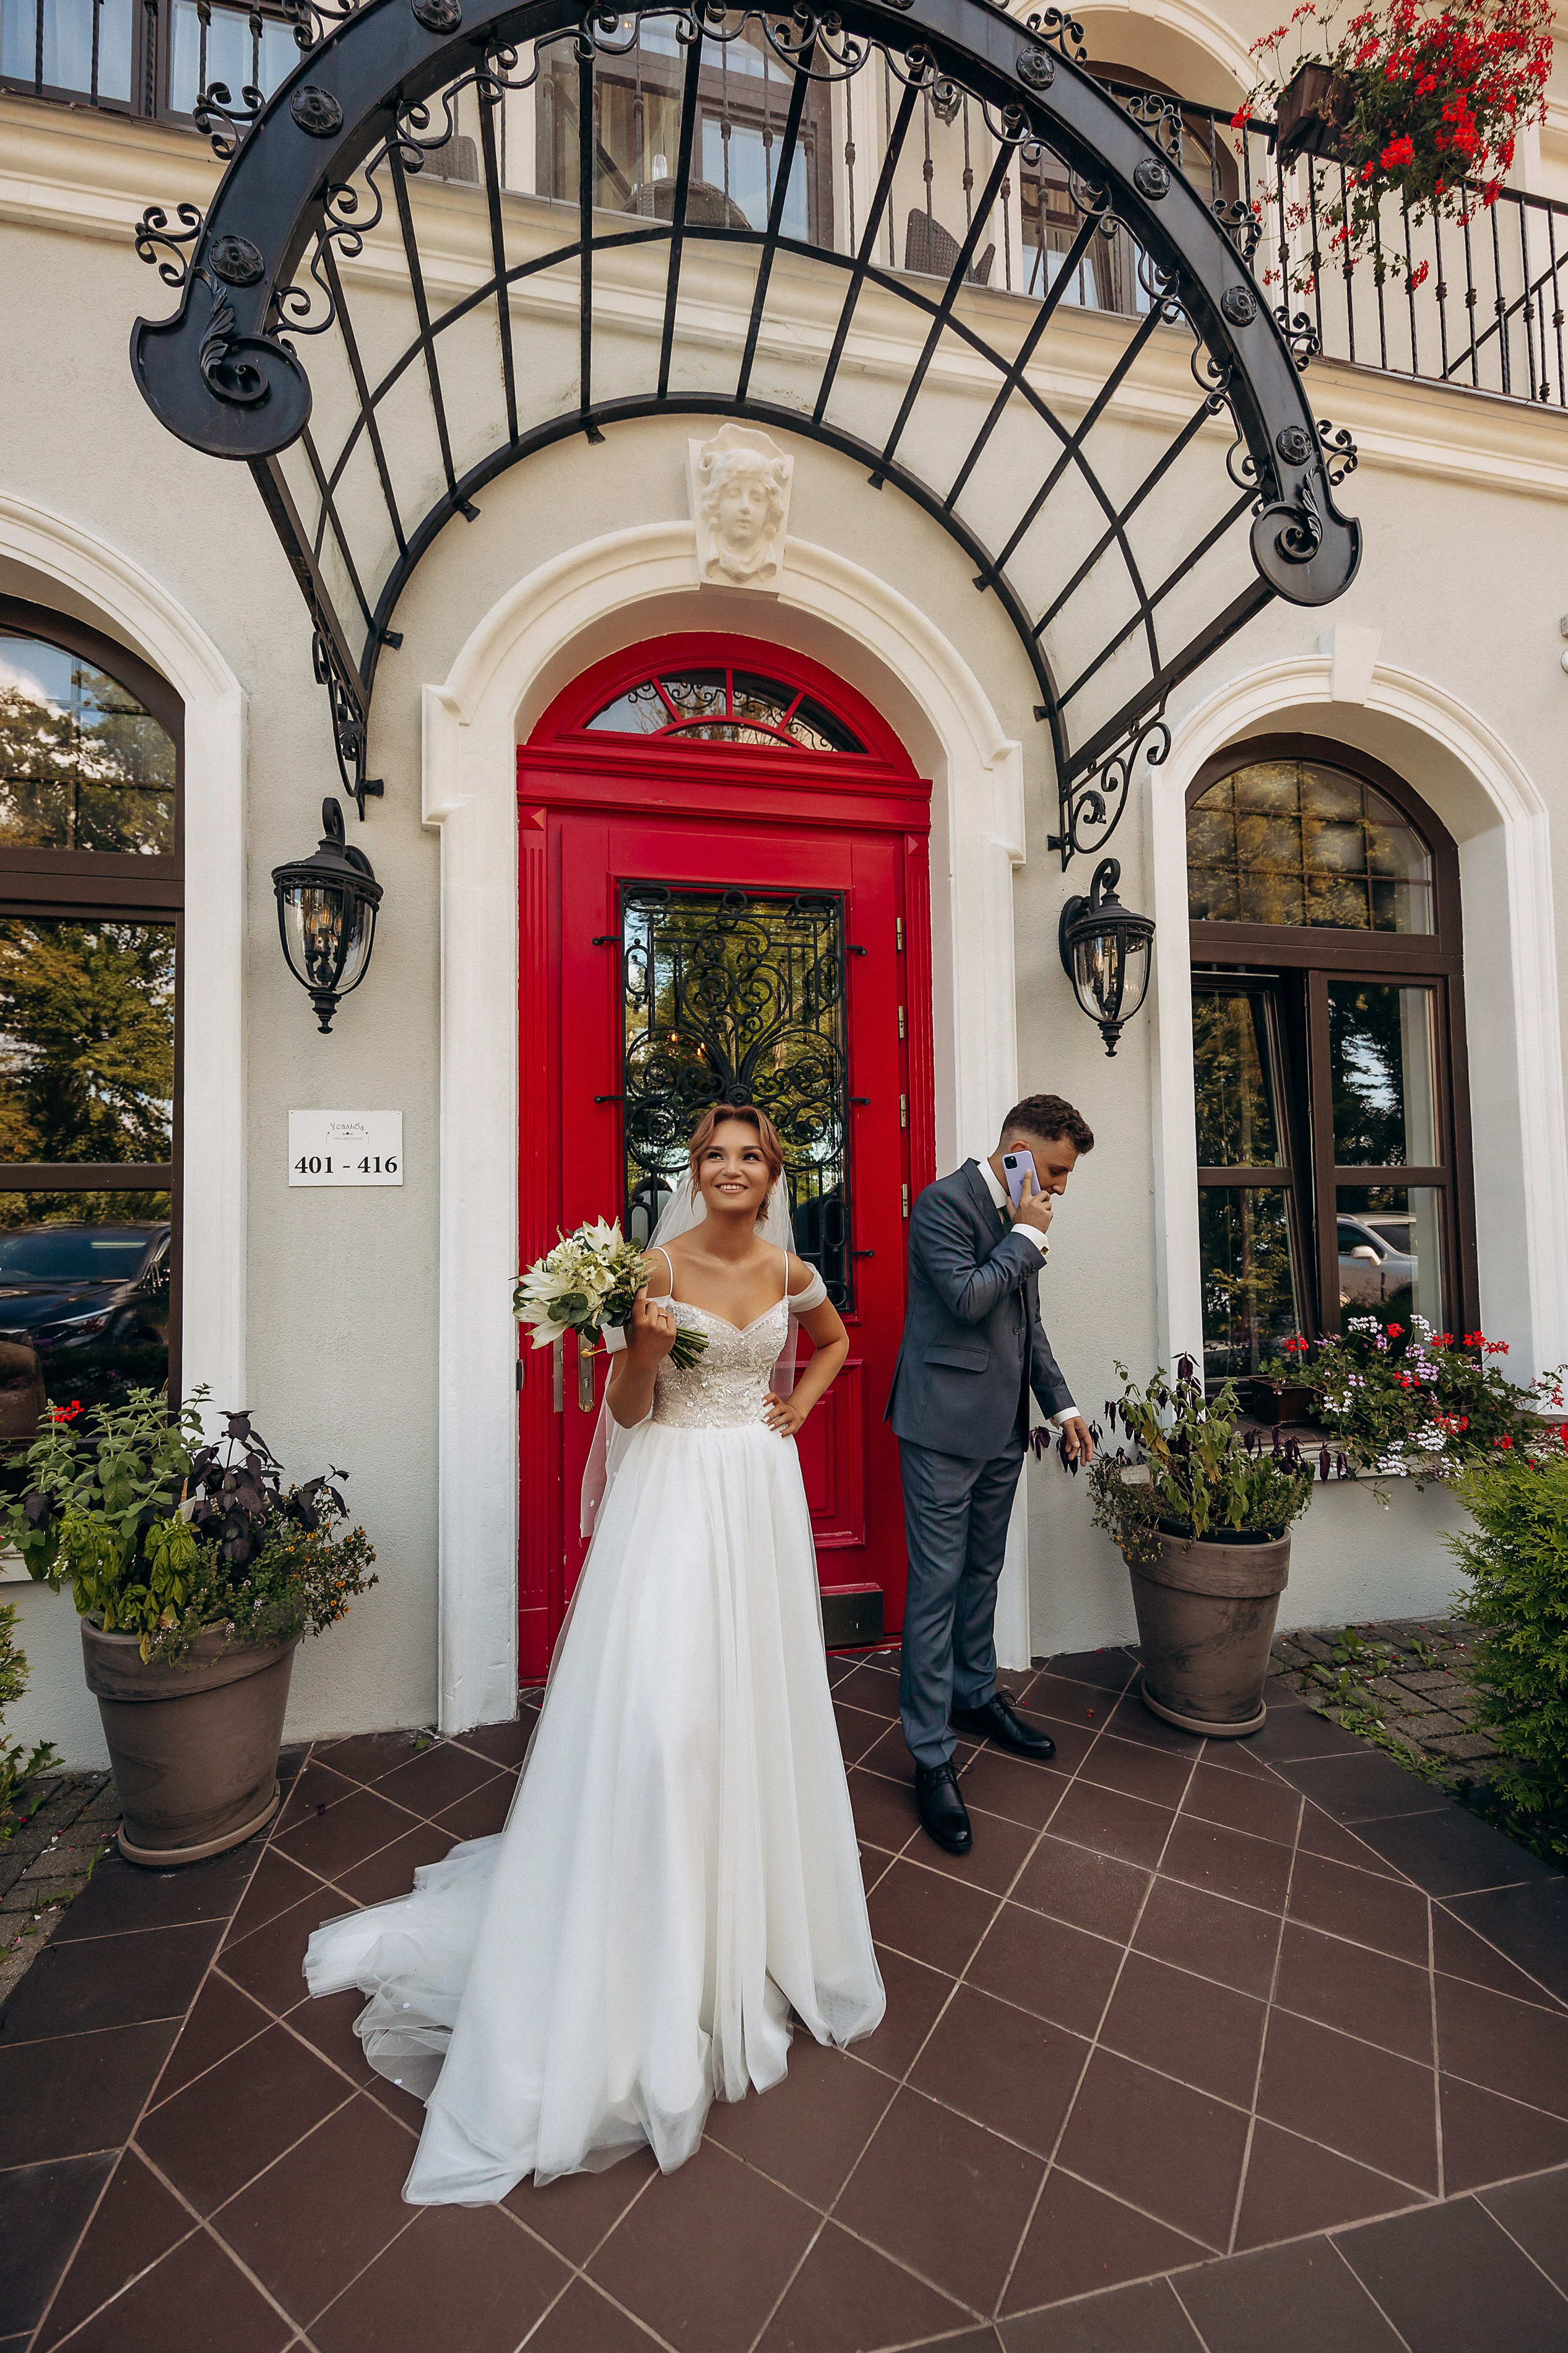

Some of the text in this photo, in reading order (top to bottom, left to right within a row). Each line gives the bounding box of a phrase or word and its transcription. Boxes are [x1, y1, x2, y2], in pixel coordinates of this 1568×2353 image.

[330, 1123, 365, 1131] Усадьба
[294, 1156, 334, 1173] 401
[357, 1155, 397, 1173] 416
